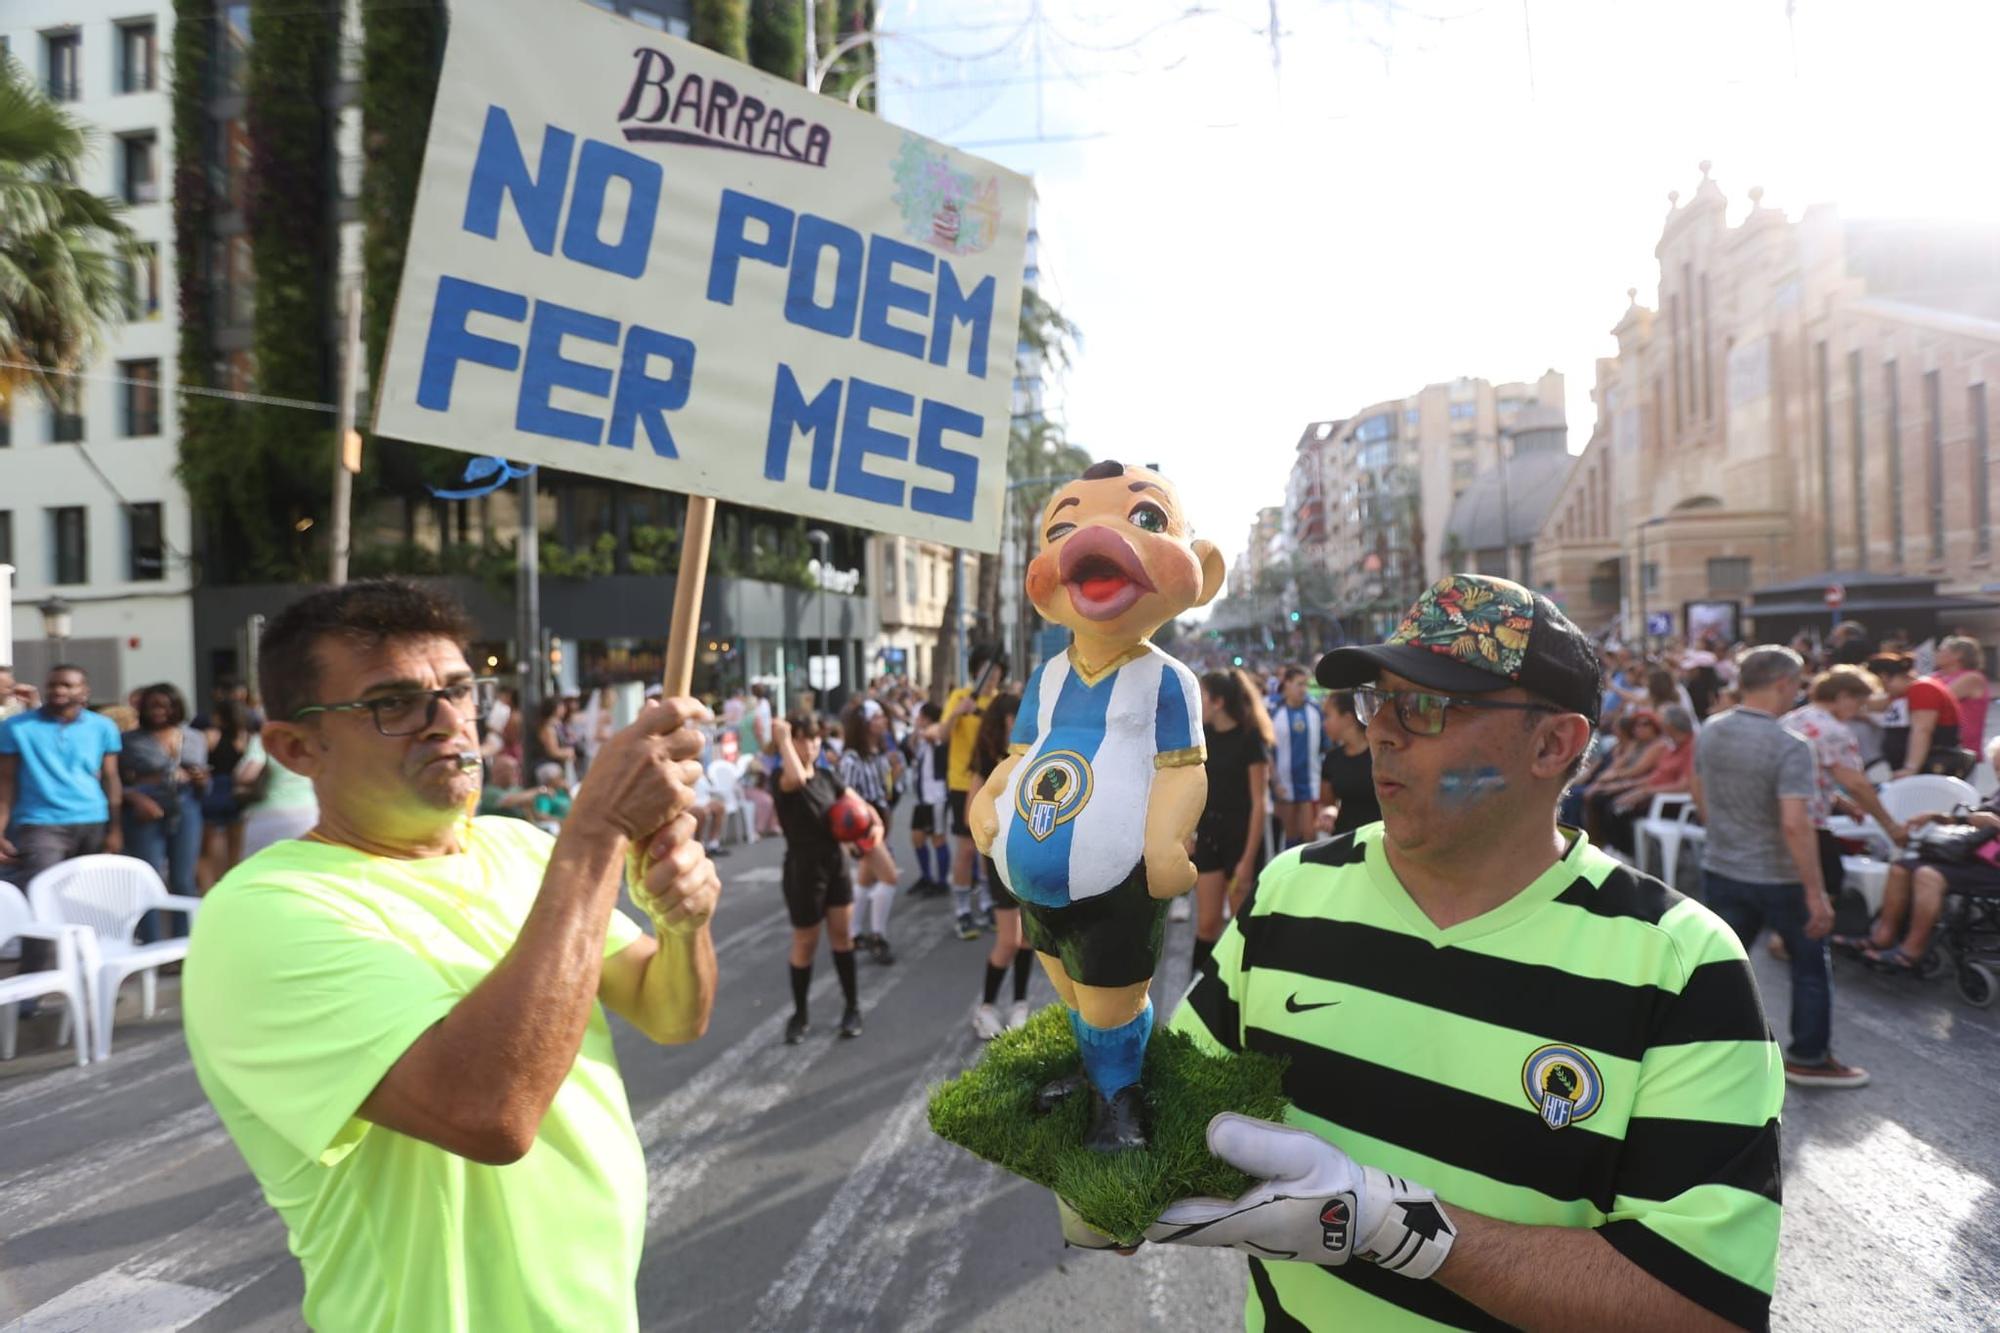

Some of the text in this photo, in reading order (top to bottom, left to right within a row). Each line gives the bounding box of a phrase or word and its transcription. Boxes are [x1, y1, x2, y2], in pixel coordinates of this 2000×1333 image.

[616, 47, 831, 168] BARRACA
[464, 105, 995, 379] NO POEM
[416, 275, 985, 522] FER MES
[1031, 803, 1057, 834] HCF
[1544, 1095, 1571, 1126] HCF
